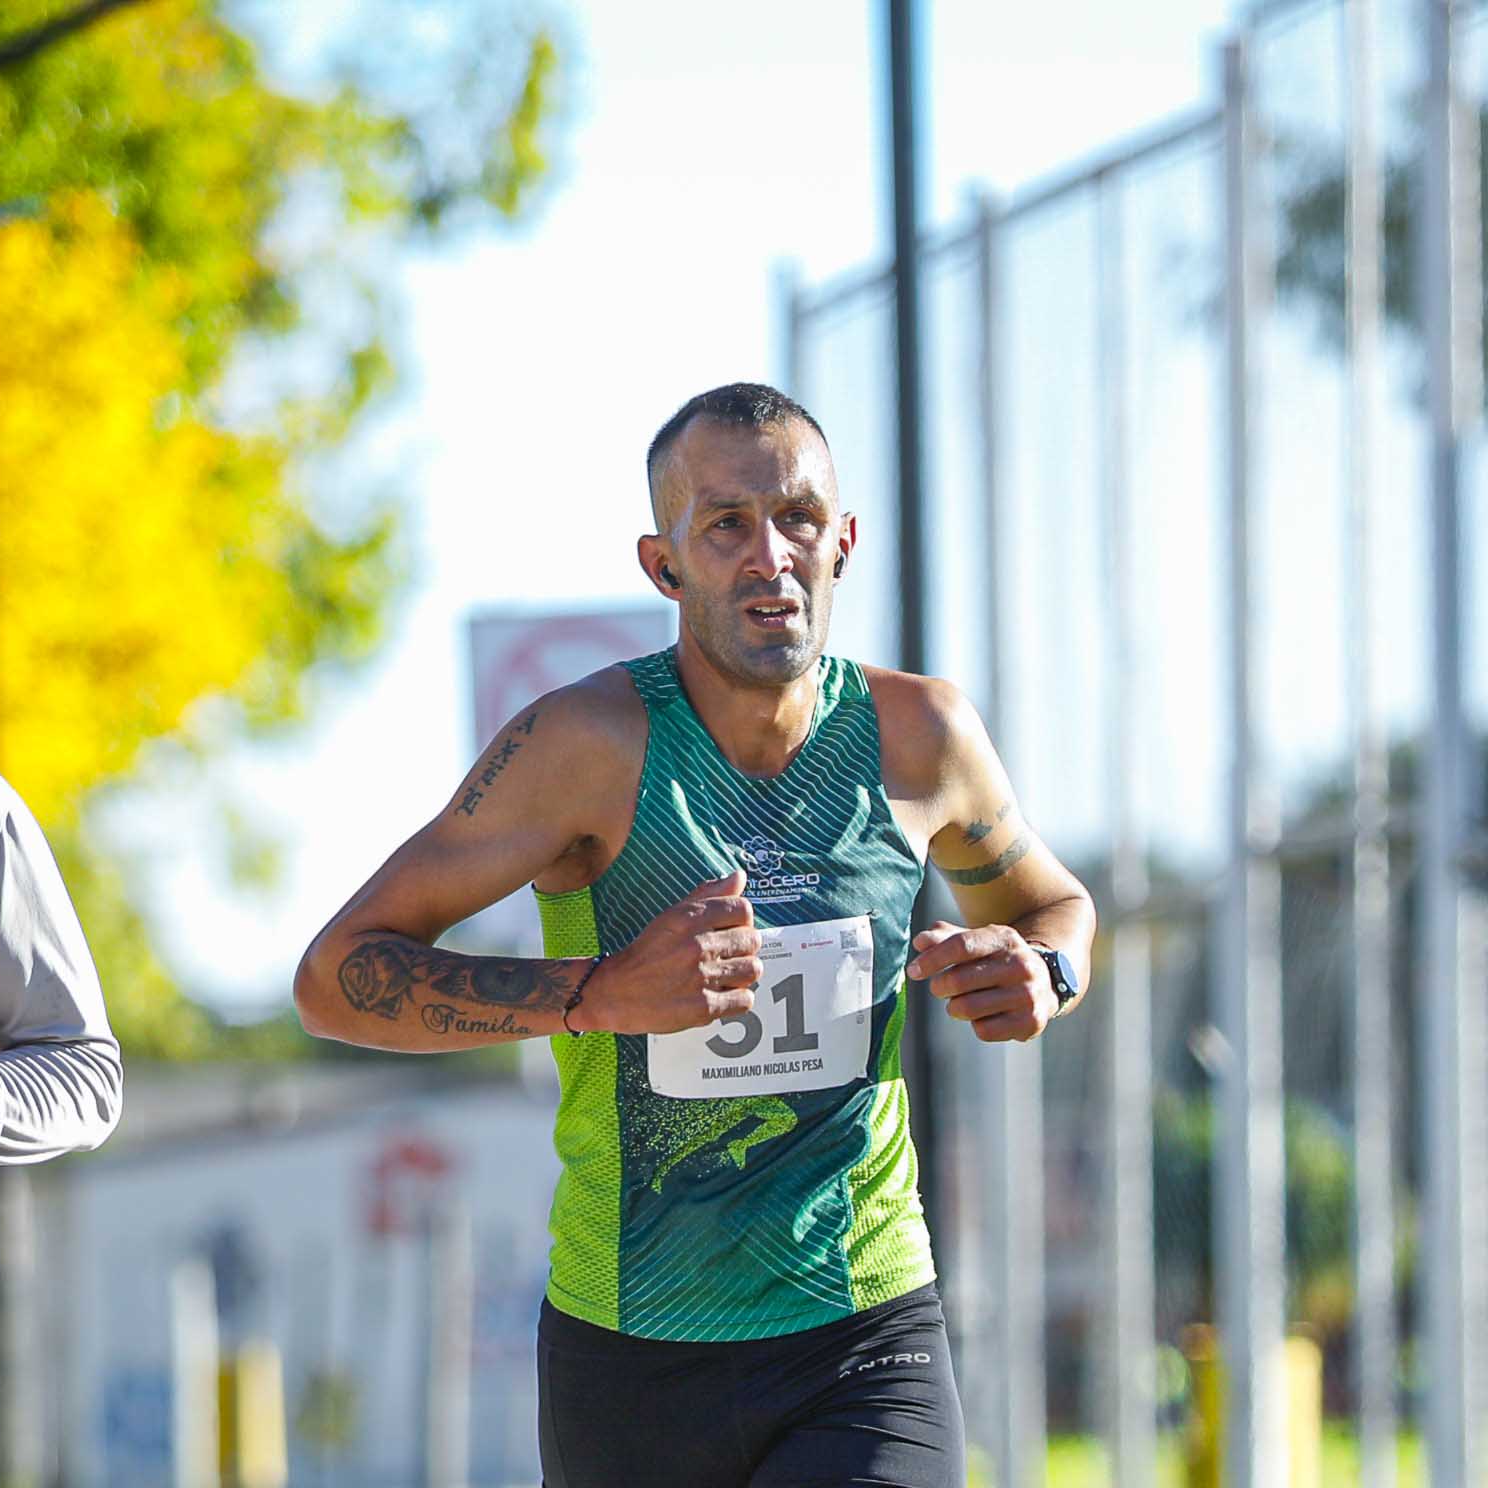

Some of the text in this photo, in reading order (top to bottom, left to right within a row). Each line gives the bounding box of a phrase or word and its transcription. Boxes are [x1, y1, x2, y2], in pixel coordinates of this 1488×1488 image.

[701, 1058, 824, 1080] MAXIMILIANO NICOLAS PESA
